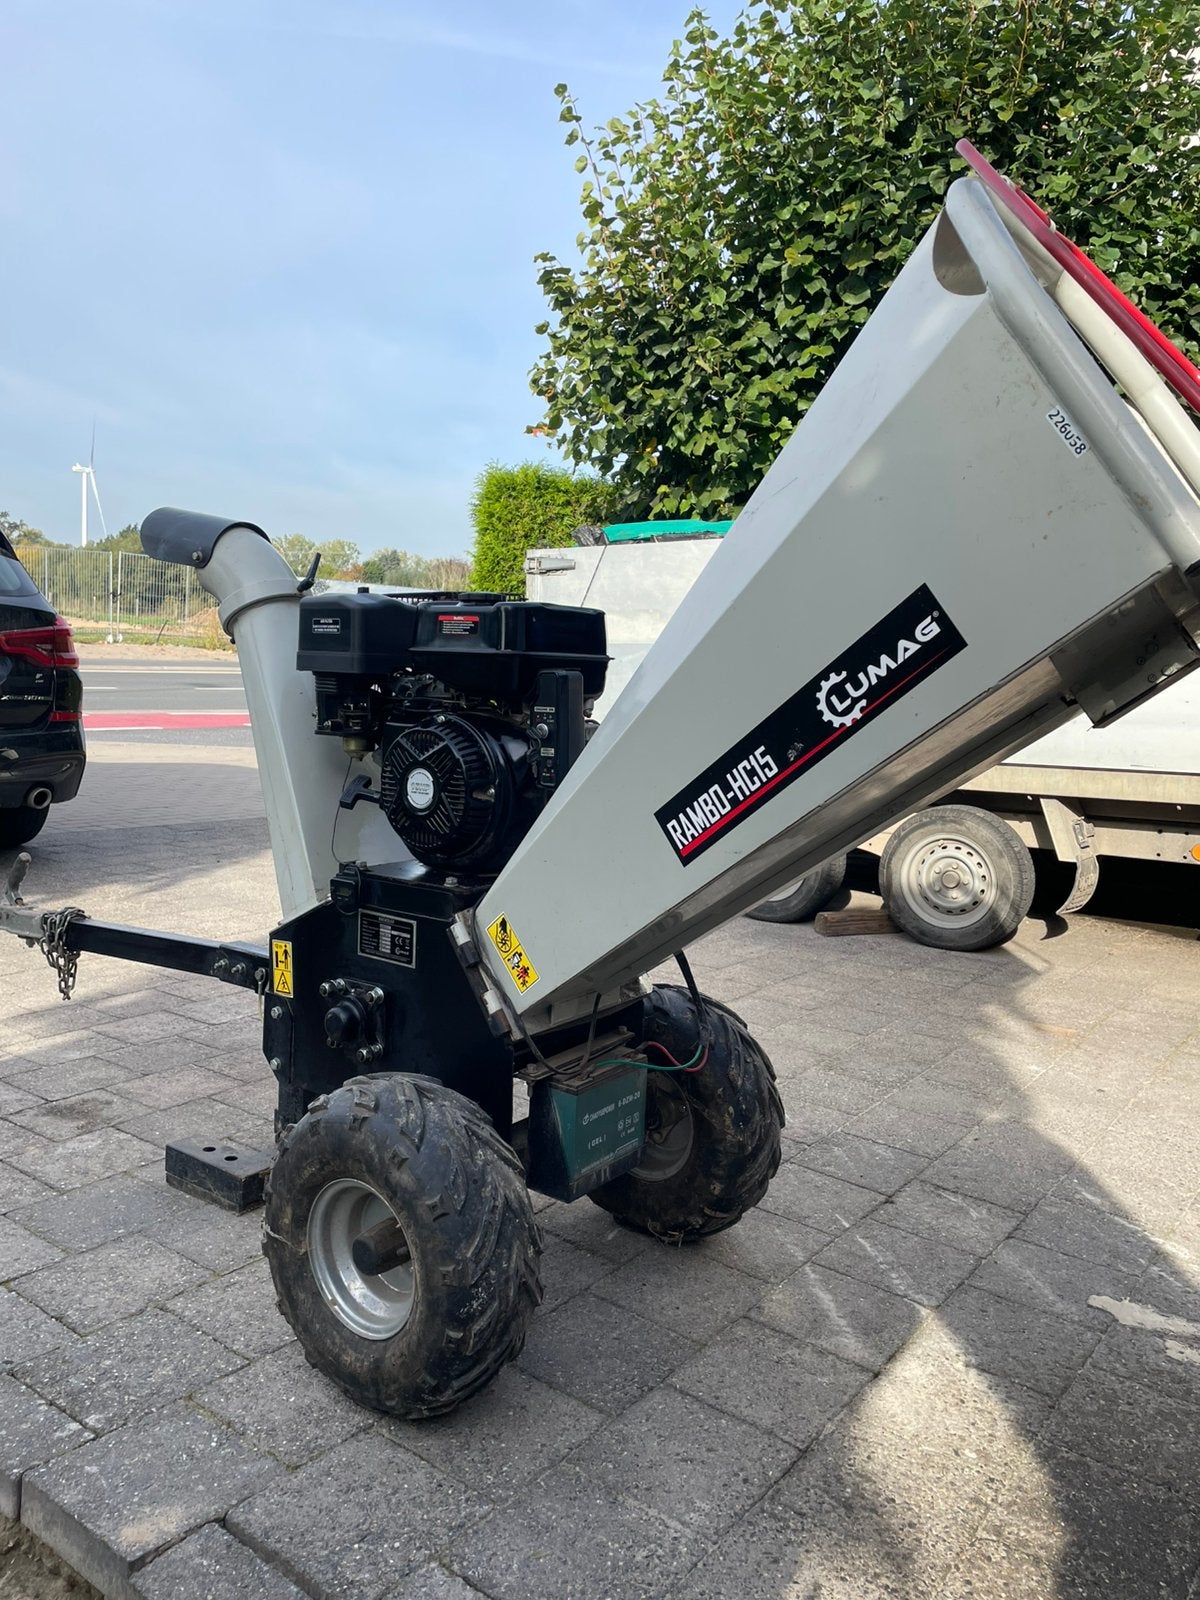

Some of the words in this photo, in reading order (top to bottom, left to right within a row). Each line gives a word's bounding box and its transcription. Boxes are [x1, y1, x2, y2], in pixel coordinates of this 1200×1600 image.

[1047, 409, 1087, 455] 226058
[830, 614, 942, 713] LUMAG
[666, 745, 779, 850] RAMBO-HC15
